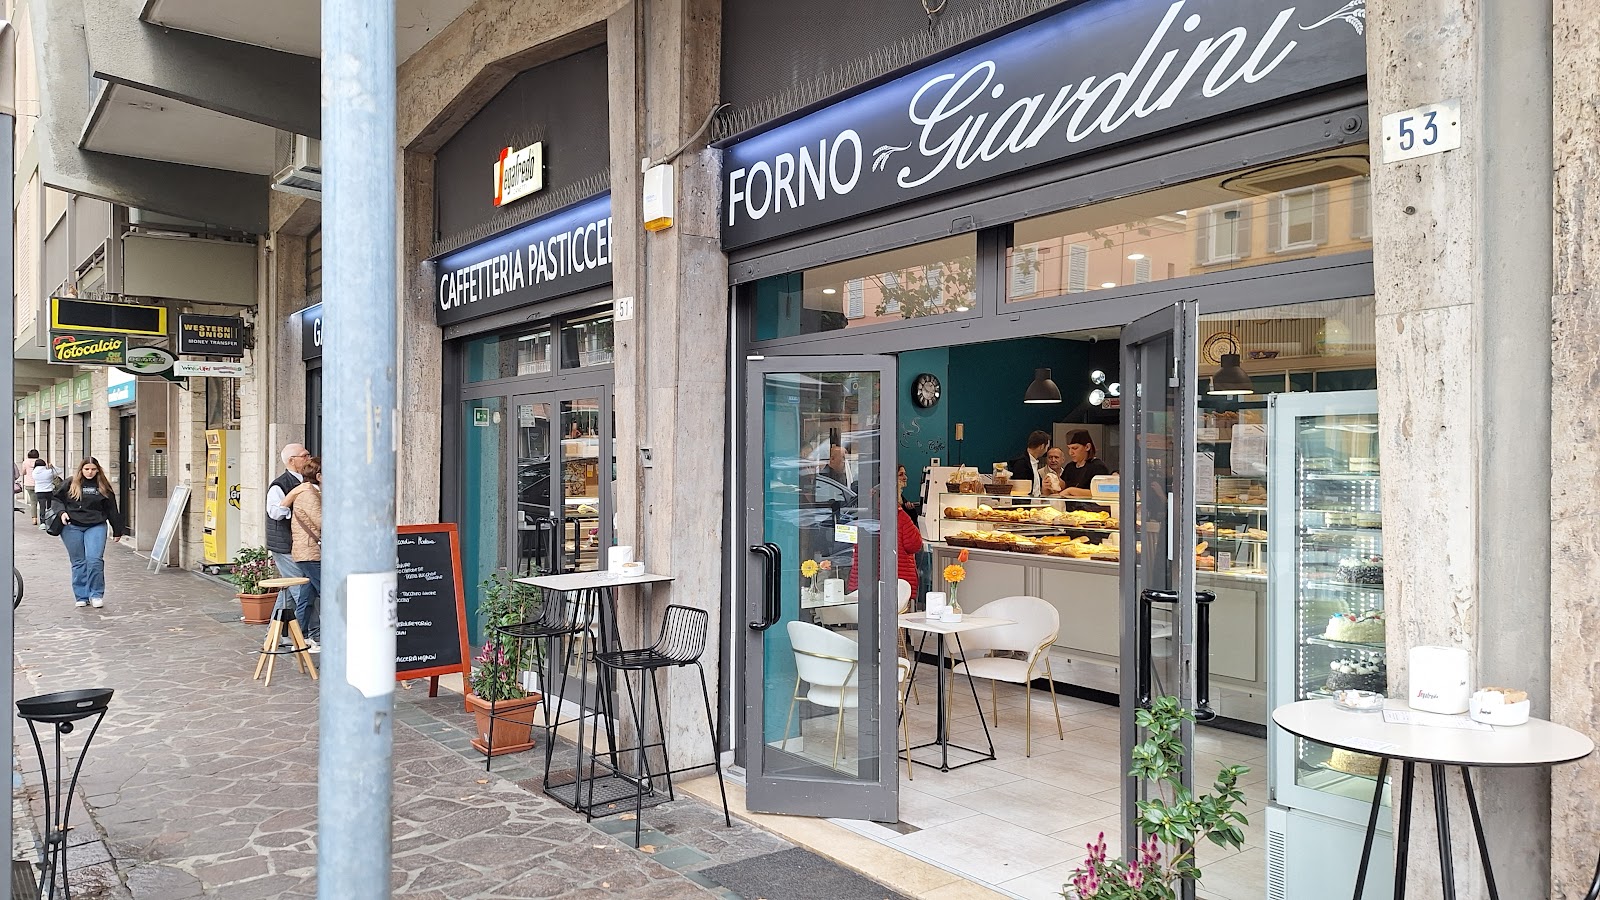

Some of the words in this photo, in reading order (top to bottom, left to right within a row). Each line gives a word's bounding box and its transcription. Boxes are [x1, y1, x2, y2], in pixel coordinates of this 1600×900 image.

[728, 129, 864, 226] FORNO
[896, 0, 1298, 189] Giardini
[1399, 110, 1439, 151] 53
[493, 146, 535, 207] Segafredo
[440, 248, 525, 311] CAFFETTERIA
[619, 301, 630, 318] 51
[183, 324, 231, 332] WESTERN
[198, 331, 231, 339] UNION
[55, 338, 122, 360] Totocalcio
